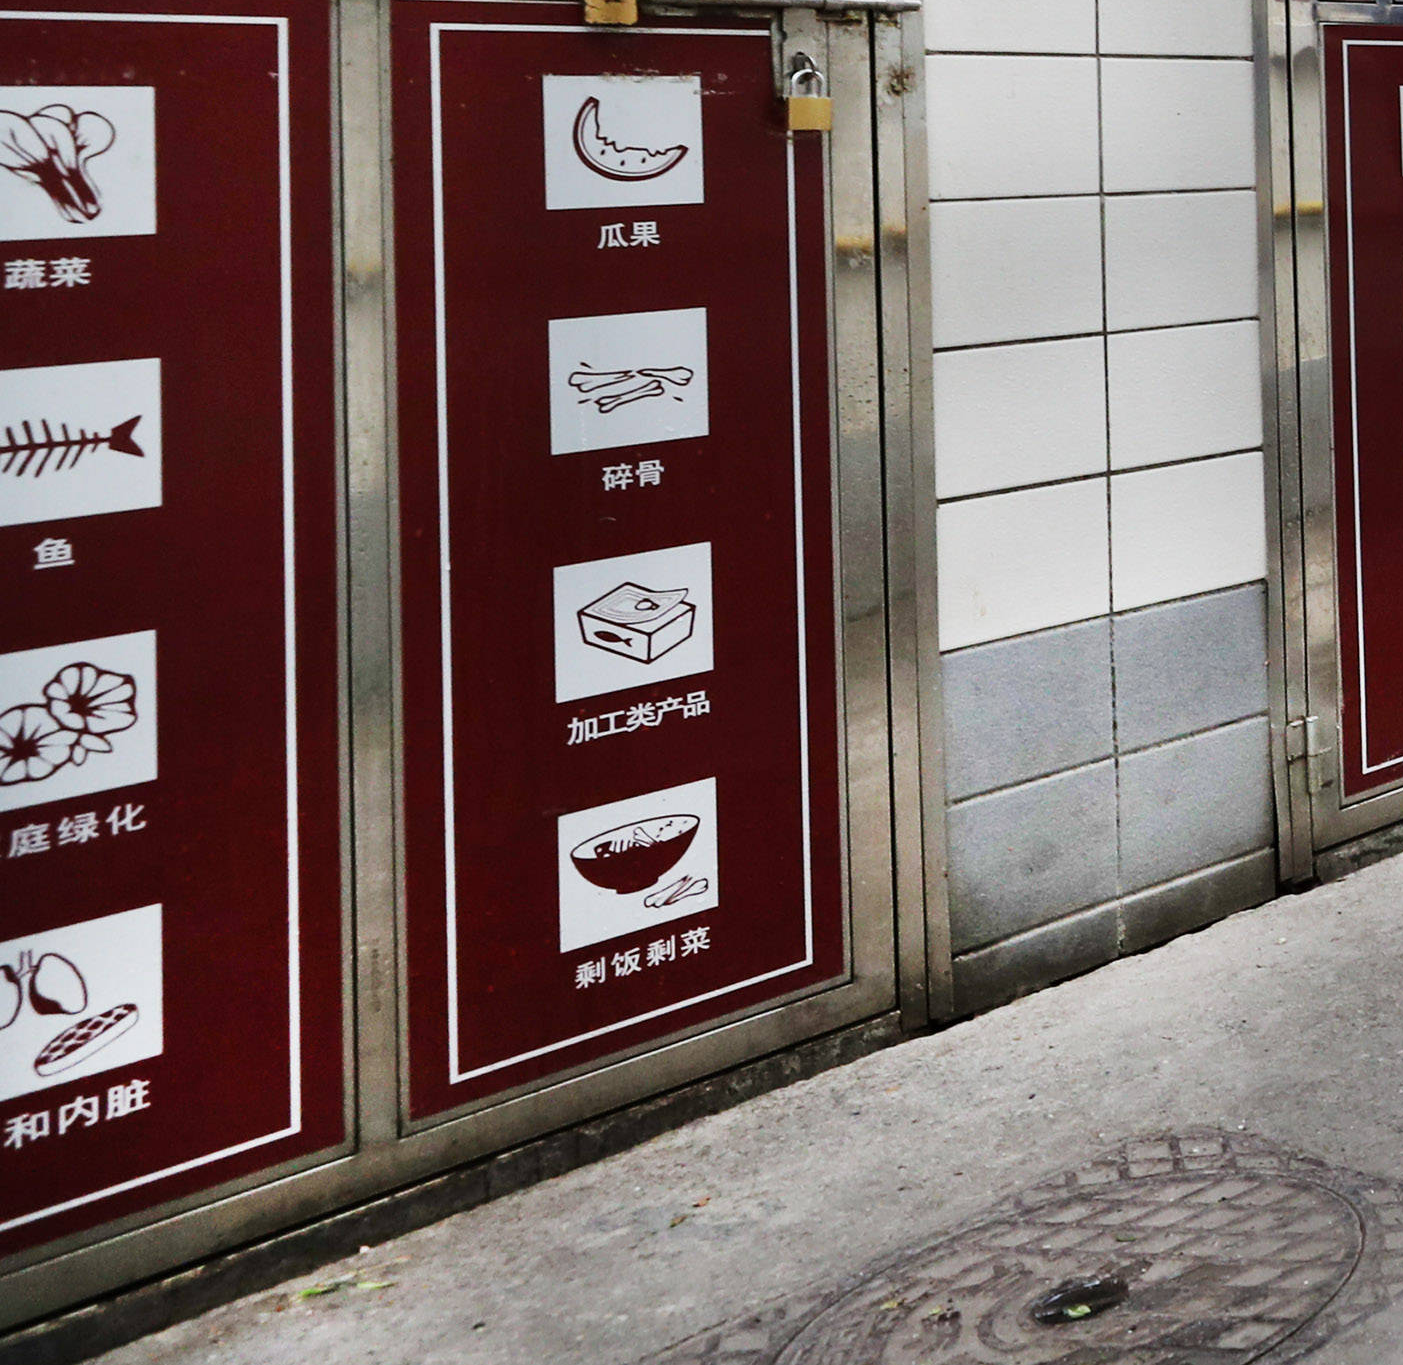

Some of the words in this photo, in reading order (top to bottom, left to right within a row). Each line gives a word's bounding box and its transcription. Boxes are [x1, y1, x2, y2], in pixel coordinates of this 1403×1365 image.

[597, 221, 661, 249] 瓜果
[4, 256, 92, 290] 蔬菜
[601, 459, 665, 492] 碎骨
[33, 537, 76, 570] 鱼
[566, 690, 711, 746] 加工类产品
[6, 802, 148, 859] 庭绿化
[574, 926, 711, 990] 剩饭剩菜
[3, 1079, 152, 1150] 和内脏
